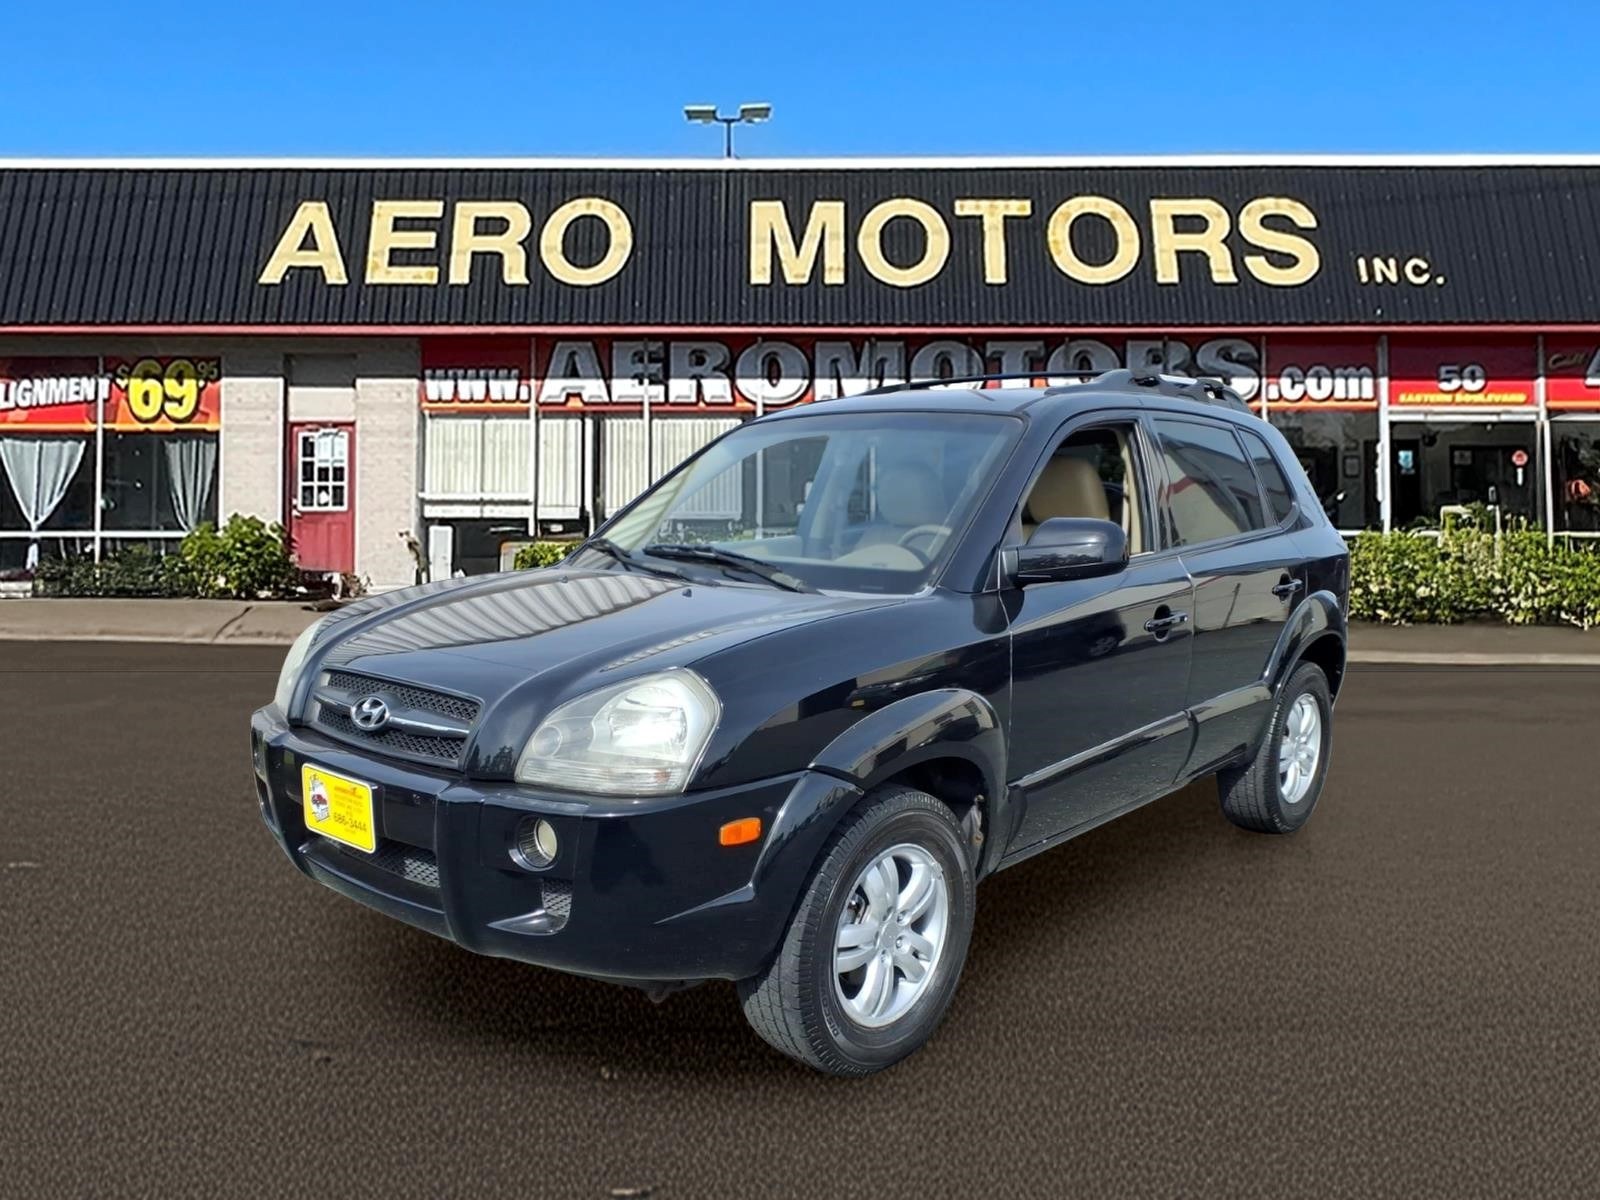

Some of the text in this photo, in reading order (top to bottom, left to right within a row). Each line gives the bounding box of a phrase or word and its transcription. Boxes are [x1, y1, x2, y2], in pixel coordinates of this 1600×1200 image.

[259, 196, 1447, 287] AERO MOTORS INC.
[1438, 364, 1486, 392] 50
